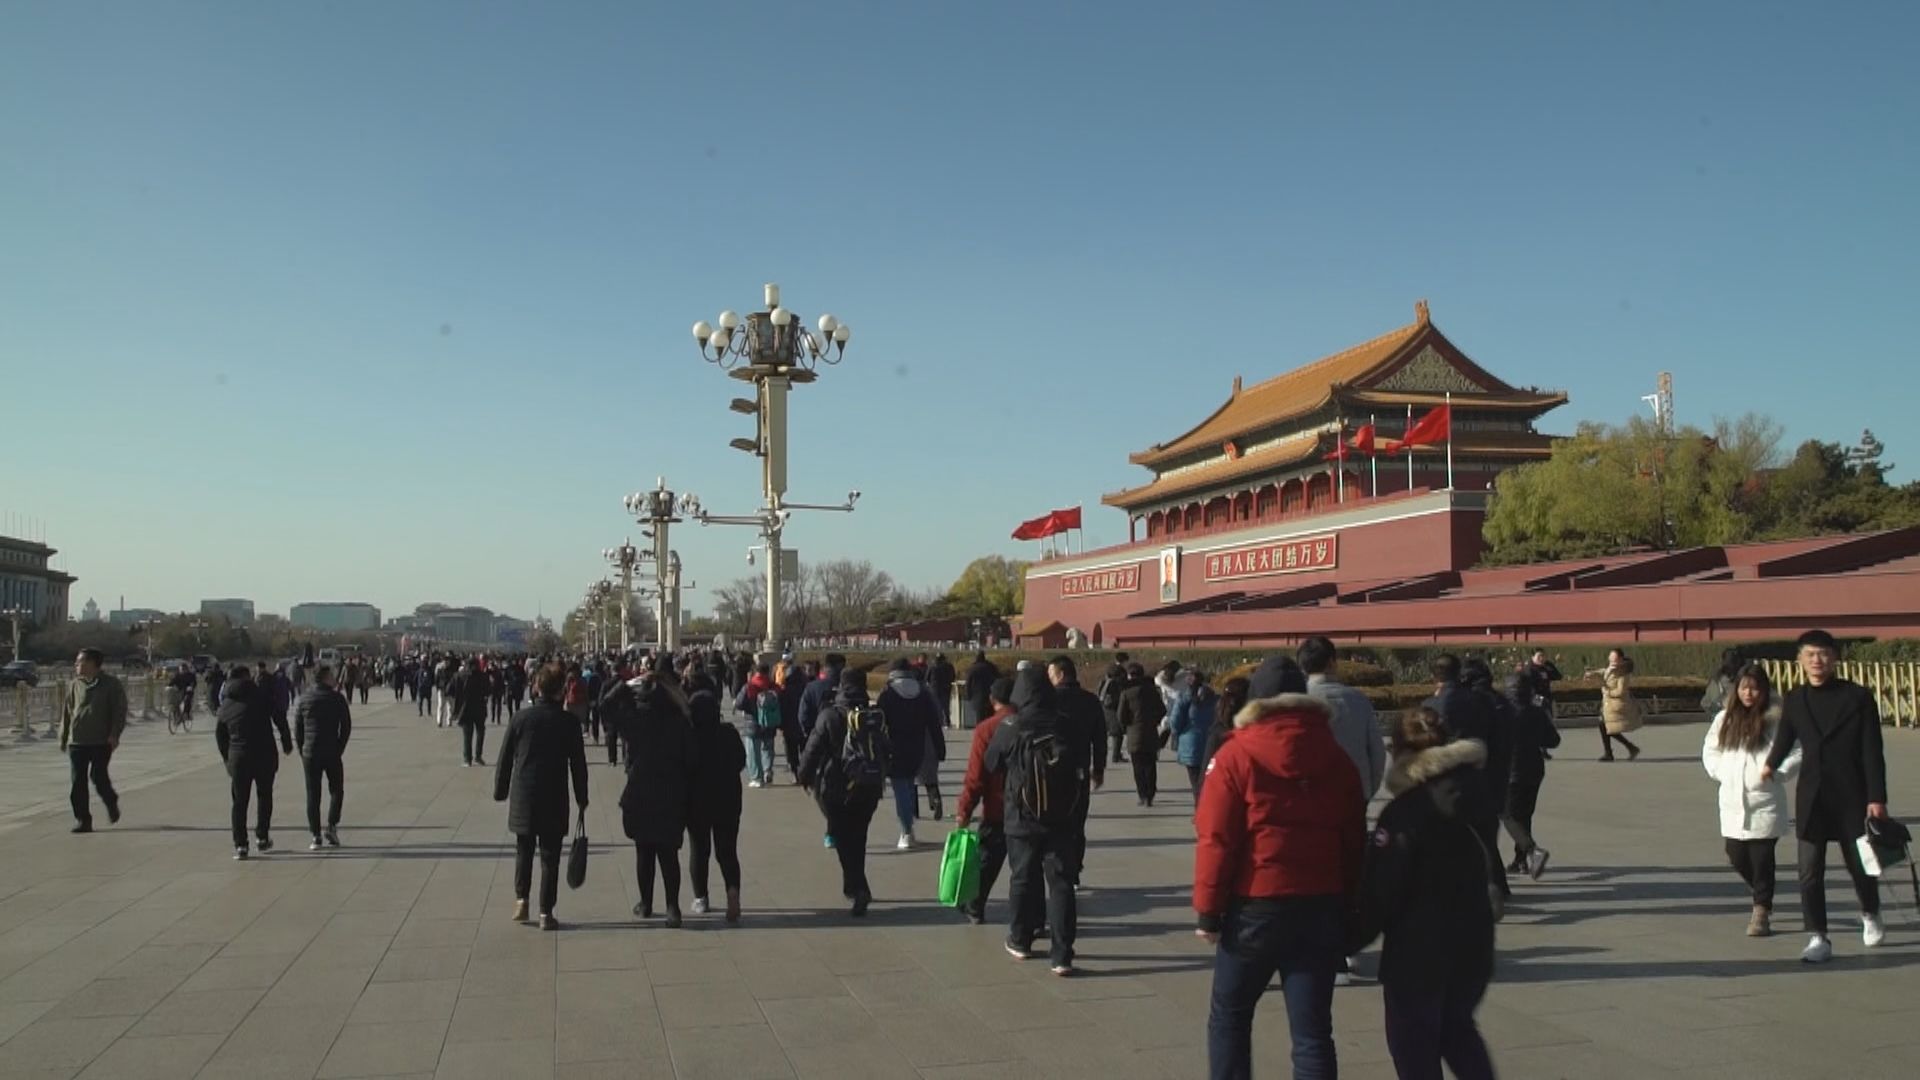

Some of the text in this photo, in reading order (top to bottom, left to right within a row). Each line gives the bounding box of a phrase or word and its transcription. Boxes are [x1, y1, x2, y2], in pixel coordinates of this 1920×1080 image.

[1211, 541, 1327, 576] 世界人民大团结万岁
